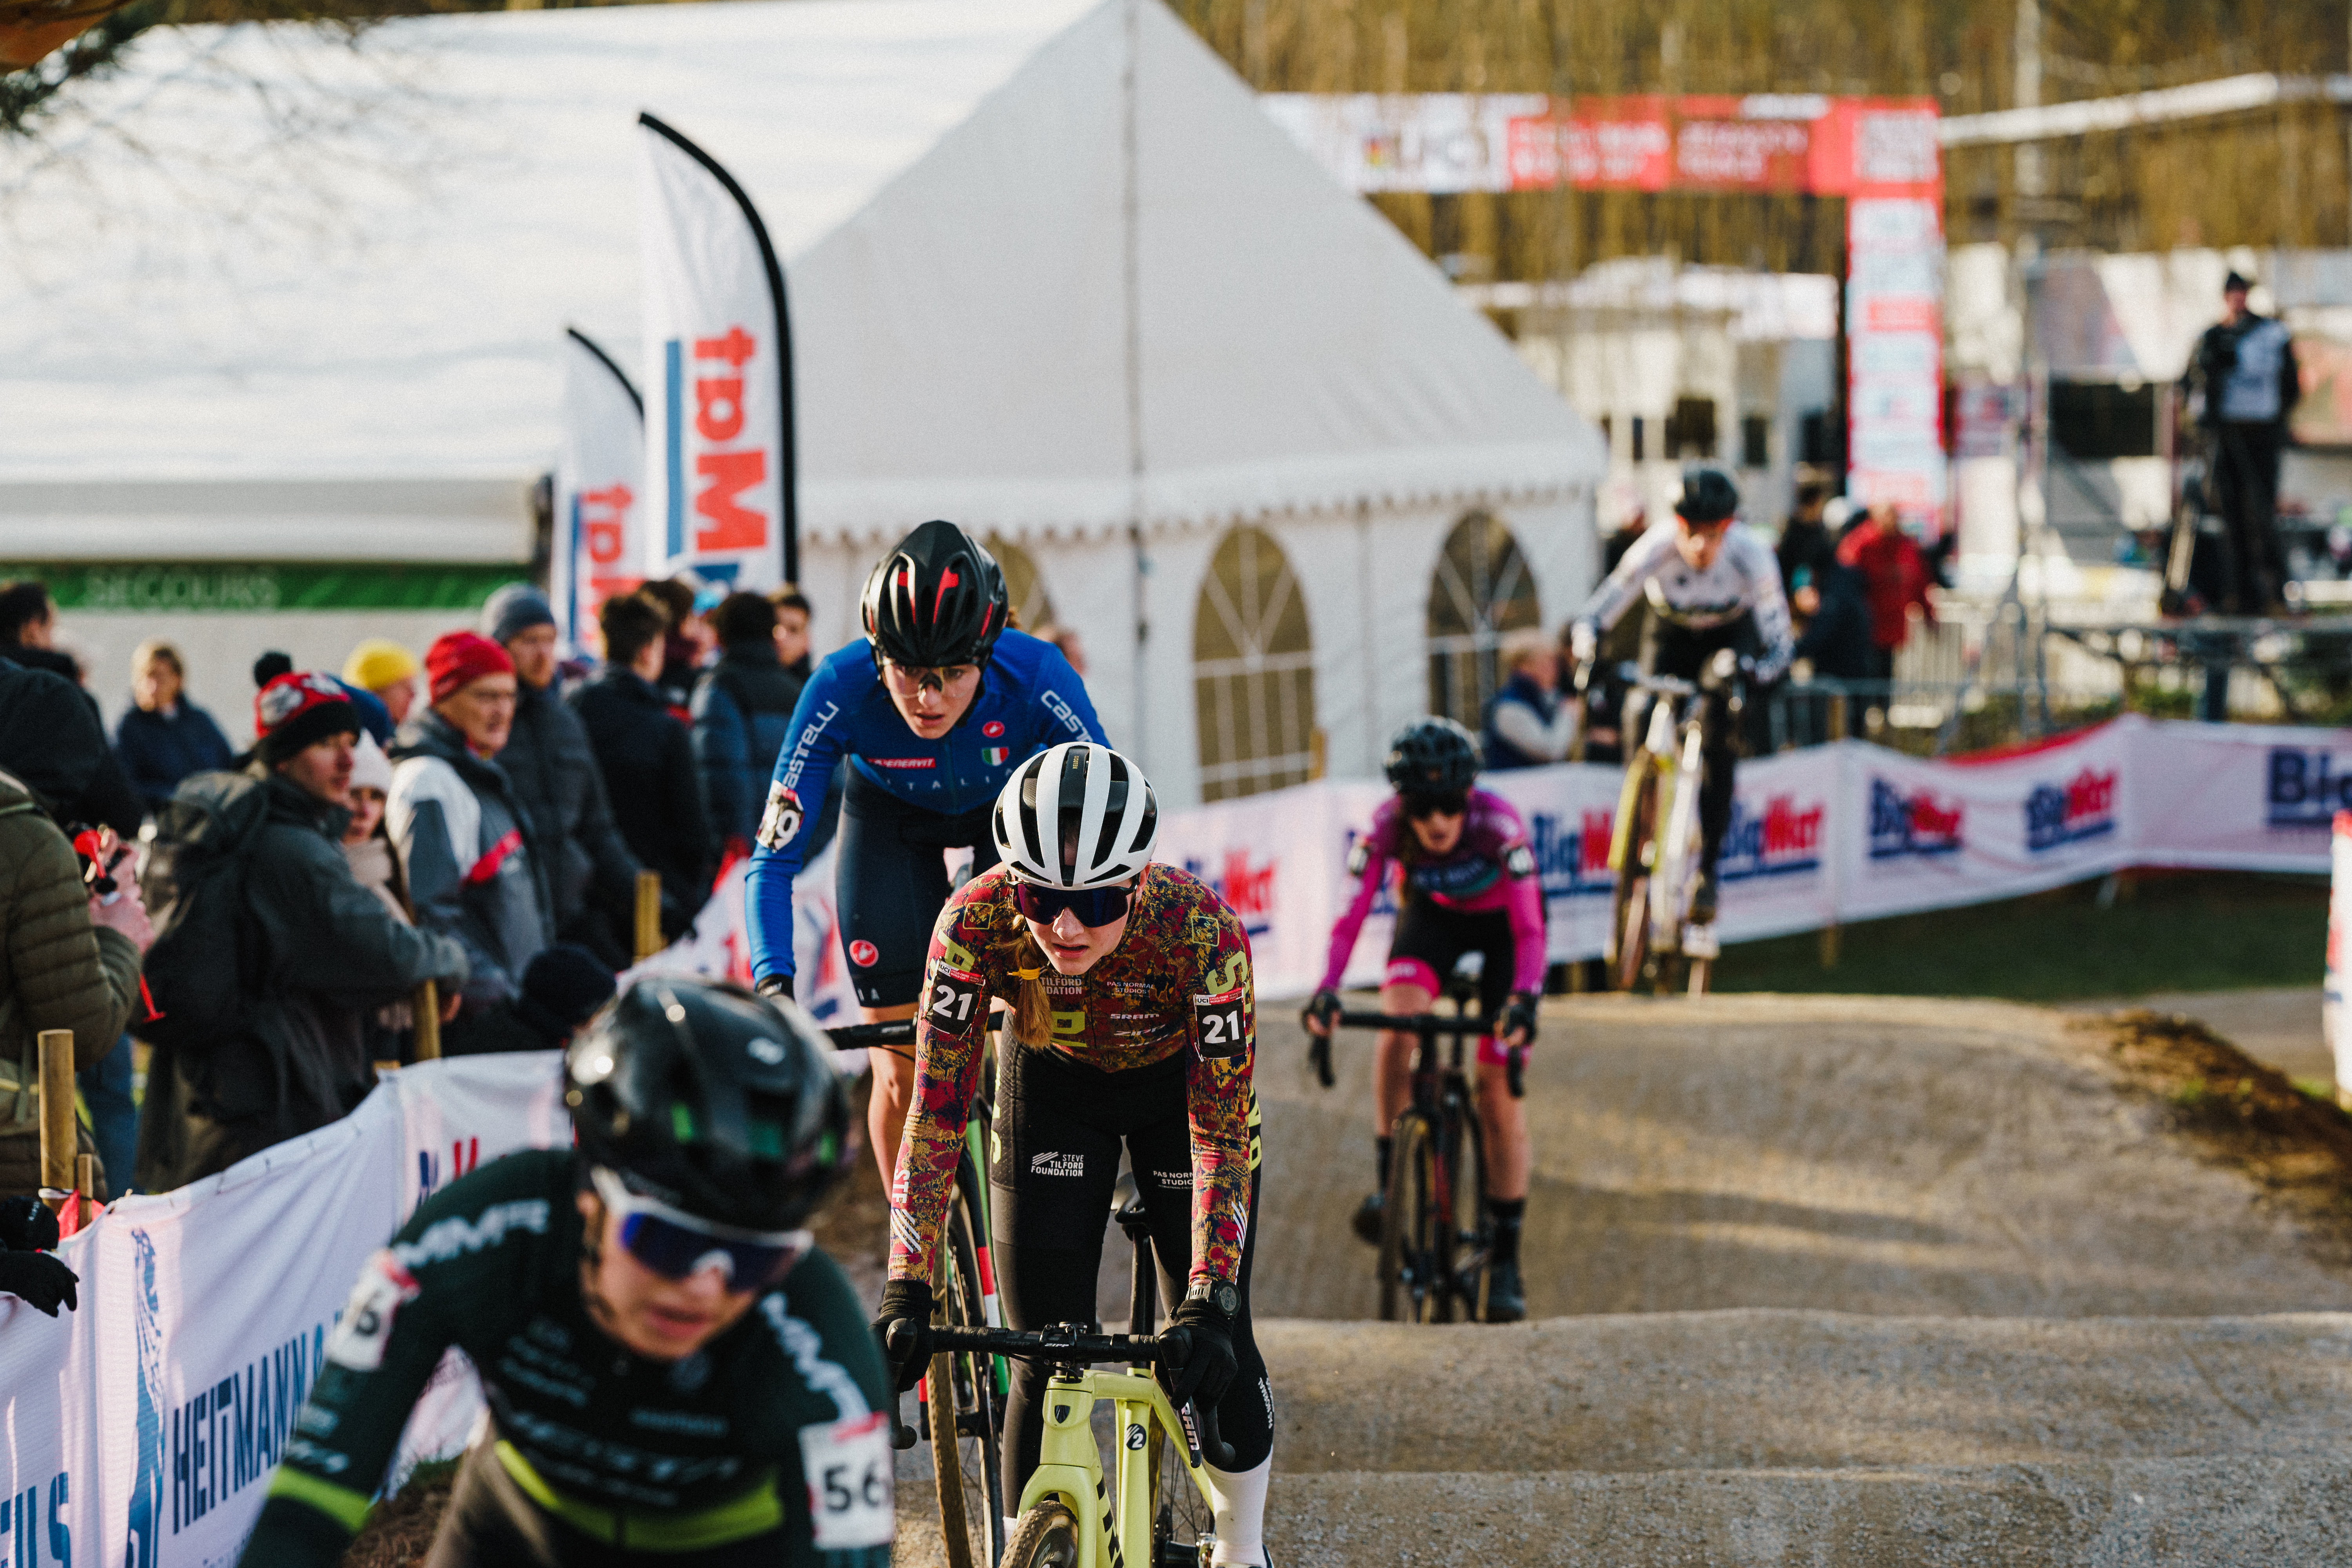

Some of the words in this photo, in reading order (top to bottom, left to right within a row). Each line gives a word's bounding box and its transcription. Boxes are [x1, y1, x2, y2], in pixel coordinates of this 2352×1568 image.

[86, 572, 278, 608] SECOURS
[940, 964, 950, 973] UCI
[1040, 977, 1082, 986] TILFORD
[933, 985, 973, 1020] 21
[1202, 1010, 1240, 1044] 21
[1031, 1166, 1083, 1176] FOUNDATION
[1050, 1161, 1083, 1169] TILFORD
[892, 1168, 910, 1204] STF
[1132, 1433, 1144, 1448] 2
[1181, 1402, 1200, 1451] RAM
[824, 1464, 890, 1513] 56
